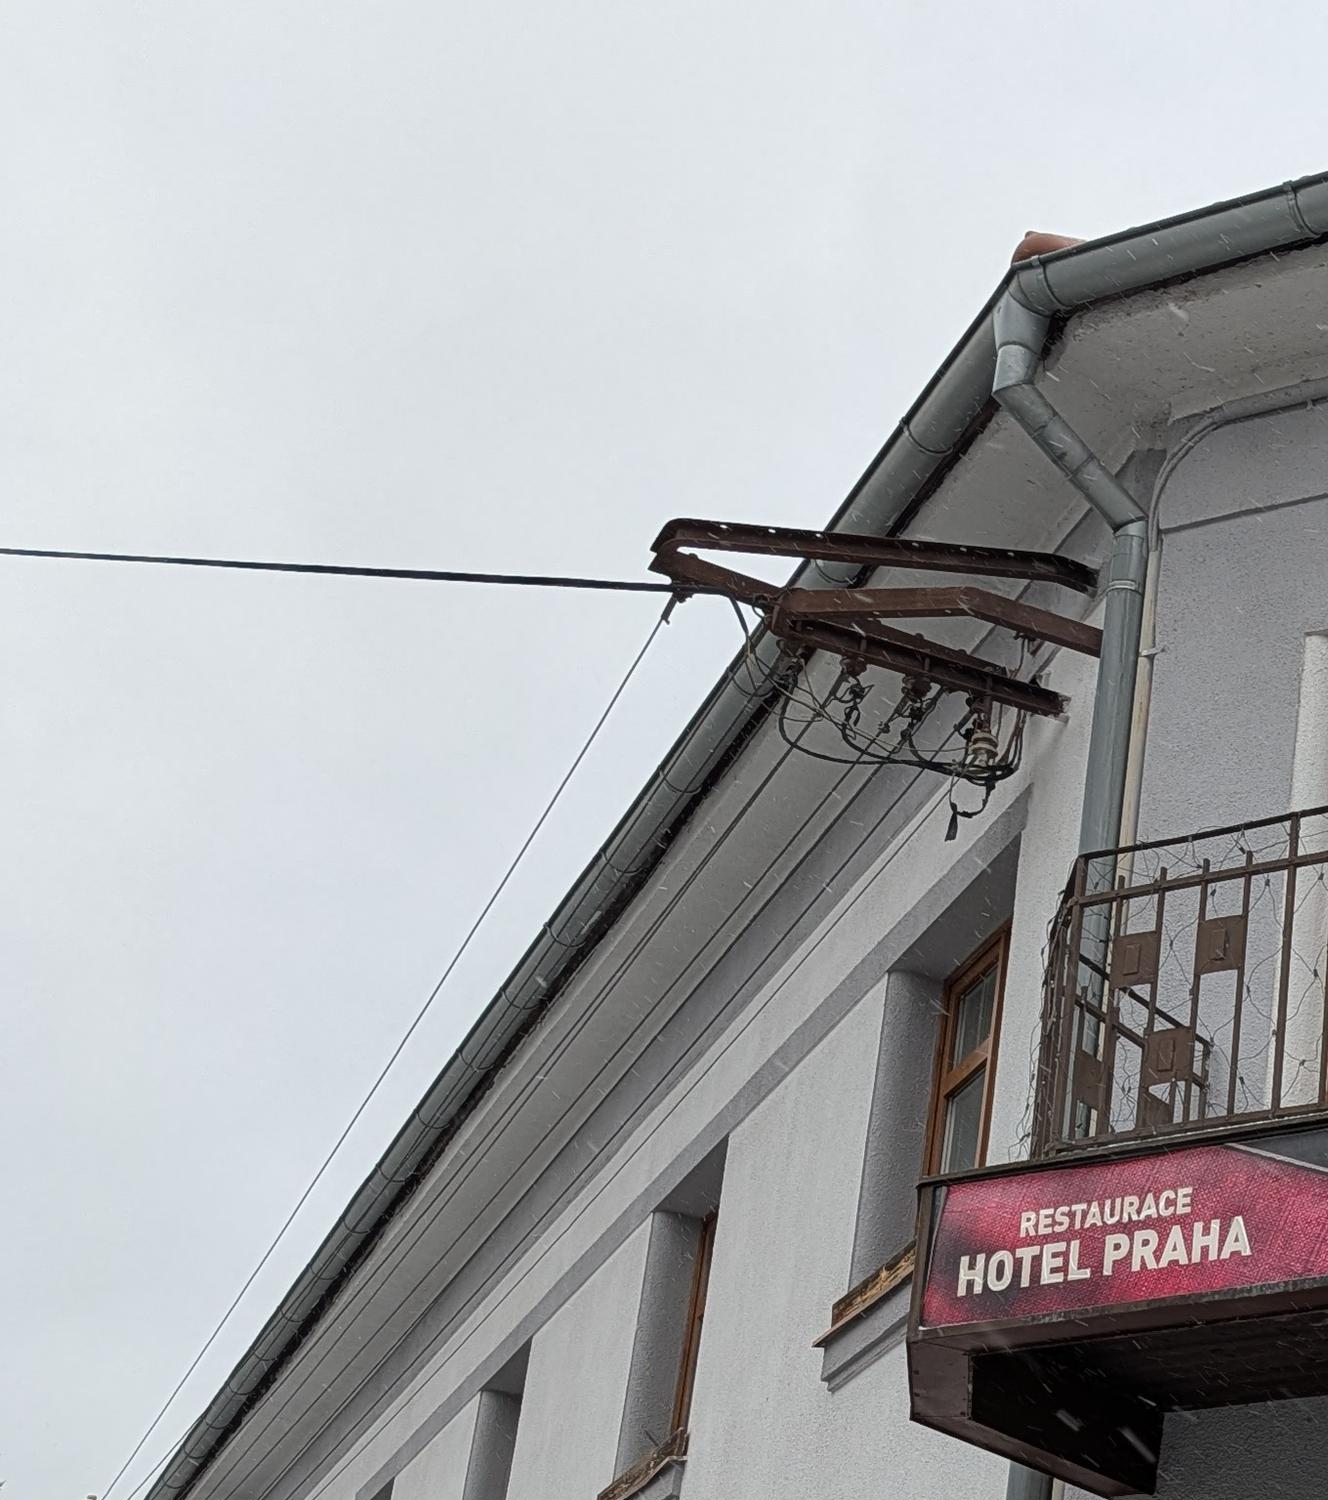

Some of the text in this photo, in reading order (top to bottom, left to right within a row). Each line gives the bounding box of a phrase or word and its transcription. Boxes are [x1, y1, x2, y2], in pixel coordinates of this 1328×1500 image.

[1019, 1186, 1193, 1238] RESTAURACE
[956, 1215, 1253, 1297] HOTEL PRAHA
